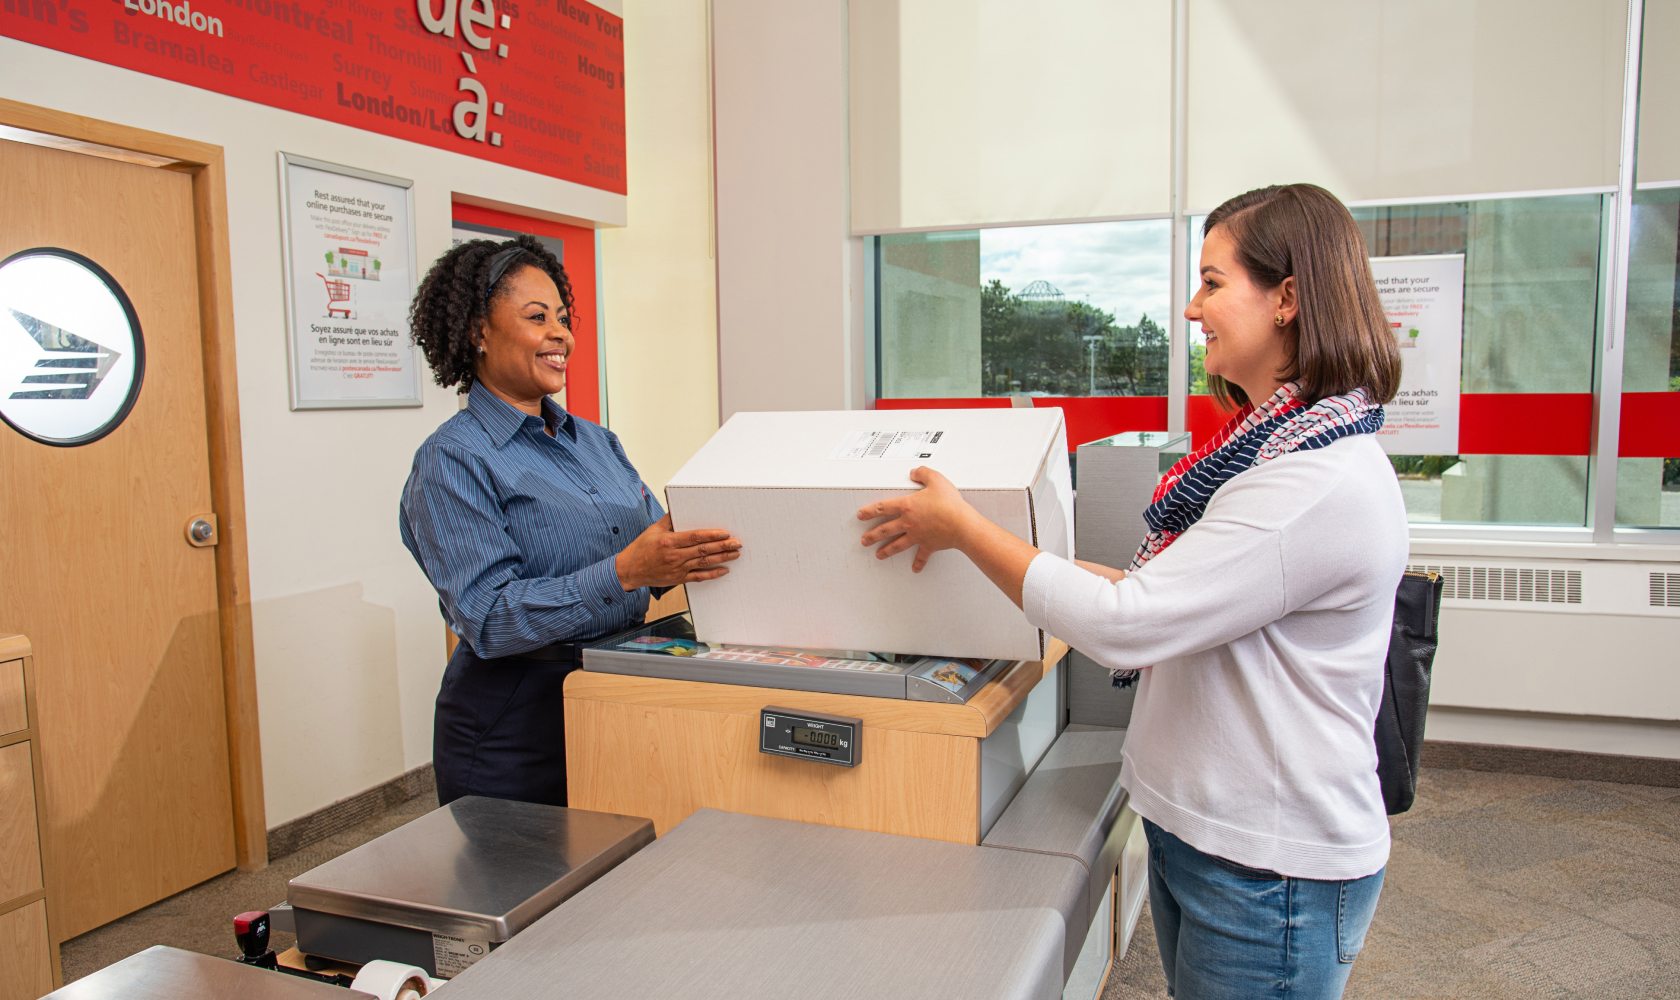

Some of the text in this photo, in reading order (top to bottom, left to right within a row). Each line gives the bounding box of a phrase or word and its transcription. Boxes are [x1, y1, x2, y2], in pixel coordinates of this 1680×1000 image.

[222, 0, 353, 46] ontréal
[112, 18, 235, 77] Bramalea
[366, 32, 443, 76] Thornhill
[246, 63, 325, 101] Castlegar
[332, 51, 393, 91] Surrey
[577, 54, 615, 90] Hong
[453, 51, 504, 147] à:
[583, 152, 621, 180] Saint
[306, 200, 394, 222] online purchases are secure
[314, 189, 386, 212] Rest assured that your
[1391, 276, 1408, 285] that
[1410, 277, 1430, 287] your
[310, 324, 399, 337] Soyez assuré que vos achats
[318, 336, 328, 344] en
[328, 335, 346, 347] ligne
[346, 337, 361, 345] sont
[361, 338, 371, 346] en
[371, 337, 383, 346] lieu
[1399, 398, 1414, 406] lieu
[1411, 388, 1439, 397] achats
[839, 738, 849, 749] kg
